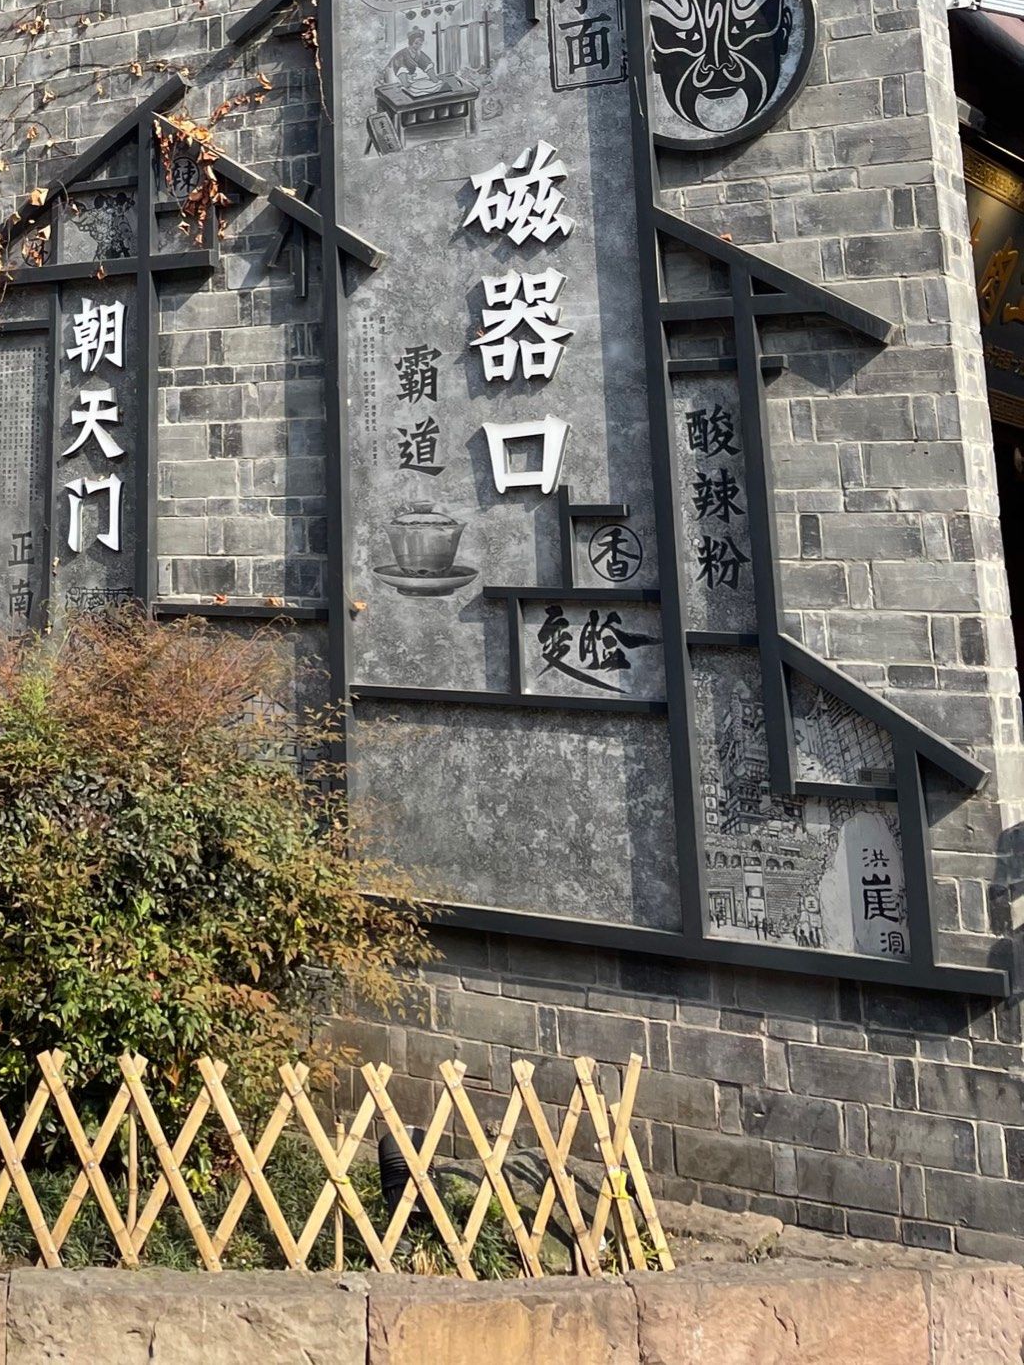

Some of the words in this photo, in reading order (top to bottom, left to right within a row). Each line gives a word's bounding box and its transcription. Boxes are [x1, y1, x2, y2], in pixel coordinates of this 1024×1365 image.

[462, 139, 577, 495] 磁器口
[63, 297, 127, 553] 朝天门
[394, 343, 446, 477] 霸道
[592, 527, 640, 578] 香
[685, 403, 752, 590] 酸辣粉
[861, 847, 905, 955] 洪崖洞
